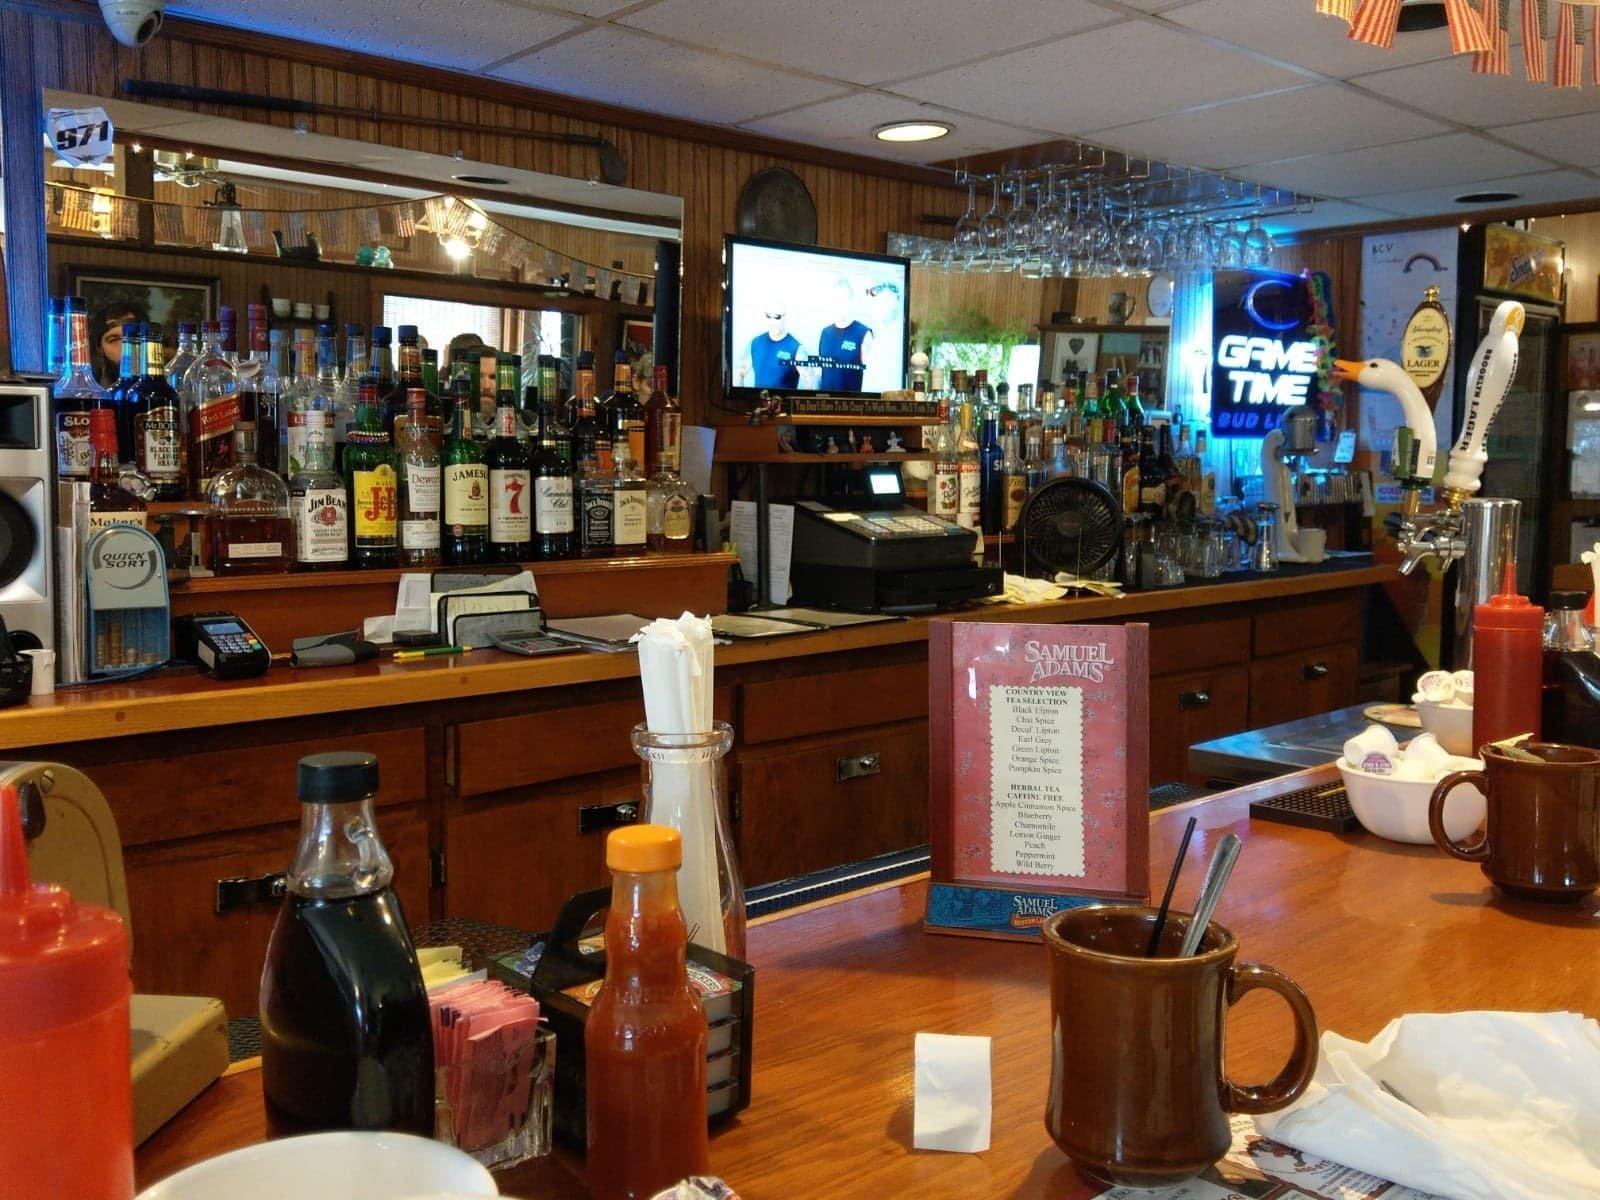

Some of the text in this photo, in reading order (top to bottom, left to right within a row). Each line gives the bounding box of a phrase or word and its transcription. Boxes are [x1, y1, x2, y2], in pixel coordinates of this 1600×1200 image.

[1218, 335, 1318, 373] GAME
[1228, 370, 1312, 405] TIME
[1459, 348, 1493, 451] BROOKLYN LAGER
[64, 416, 90, 427] SLO
[1217, 412, 1259, 429] BUD
[504, 480, 524, 514] 7
[308, 498, 325, 513] JIM
[102, 552, 145, 561] QUICK
[105, 560, 148, 568] SORT
[1024, 640, 1114, 664] SAMUEL
[1029, 661, 1104, 683] ADAMS
[1005, 688, 1067, 697] COUNTRY VIEW
[1021, 698, 1068, 706] SELECTION
[1012, 706, 1060, 716] Black Lipton
[1016, 716, 1055, 726] Chai Spice
[1011, 725, 1061, 736] Decaf Lipton
[1018, 735, 1052, 745] Earl Grey
[1012, 745, 1060, 755] Green Lipton
[1011, 754, 1060, 765] Orange Spice
[1008, 764, 1063, 775] Pumpkin Spice
[1043, 794, 1064, 802] FREE
[996, 801, 1077, 813] Apple Cinnamon Spice
[1017, 811, 1052, 821] Blueberry
[1014, 821, 1056, 830] Chamomile
[1009, 831, 1062, 841] Lemon Ginger
[1024, 841, 1046, 849] Peach
[1015, 850, 1055, 860] Peppermint
[1016, 860, 1054, 871] Wild Berry
[1013, 895, 1058, 910] SAMUEL
[1015, 904, 1054, 917] ADAMS
